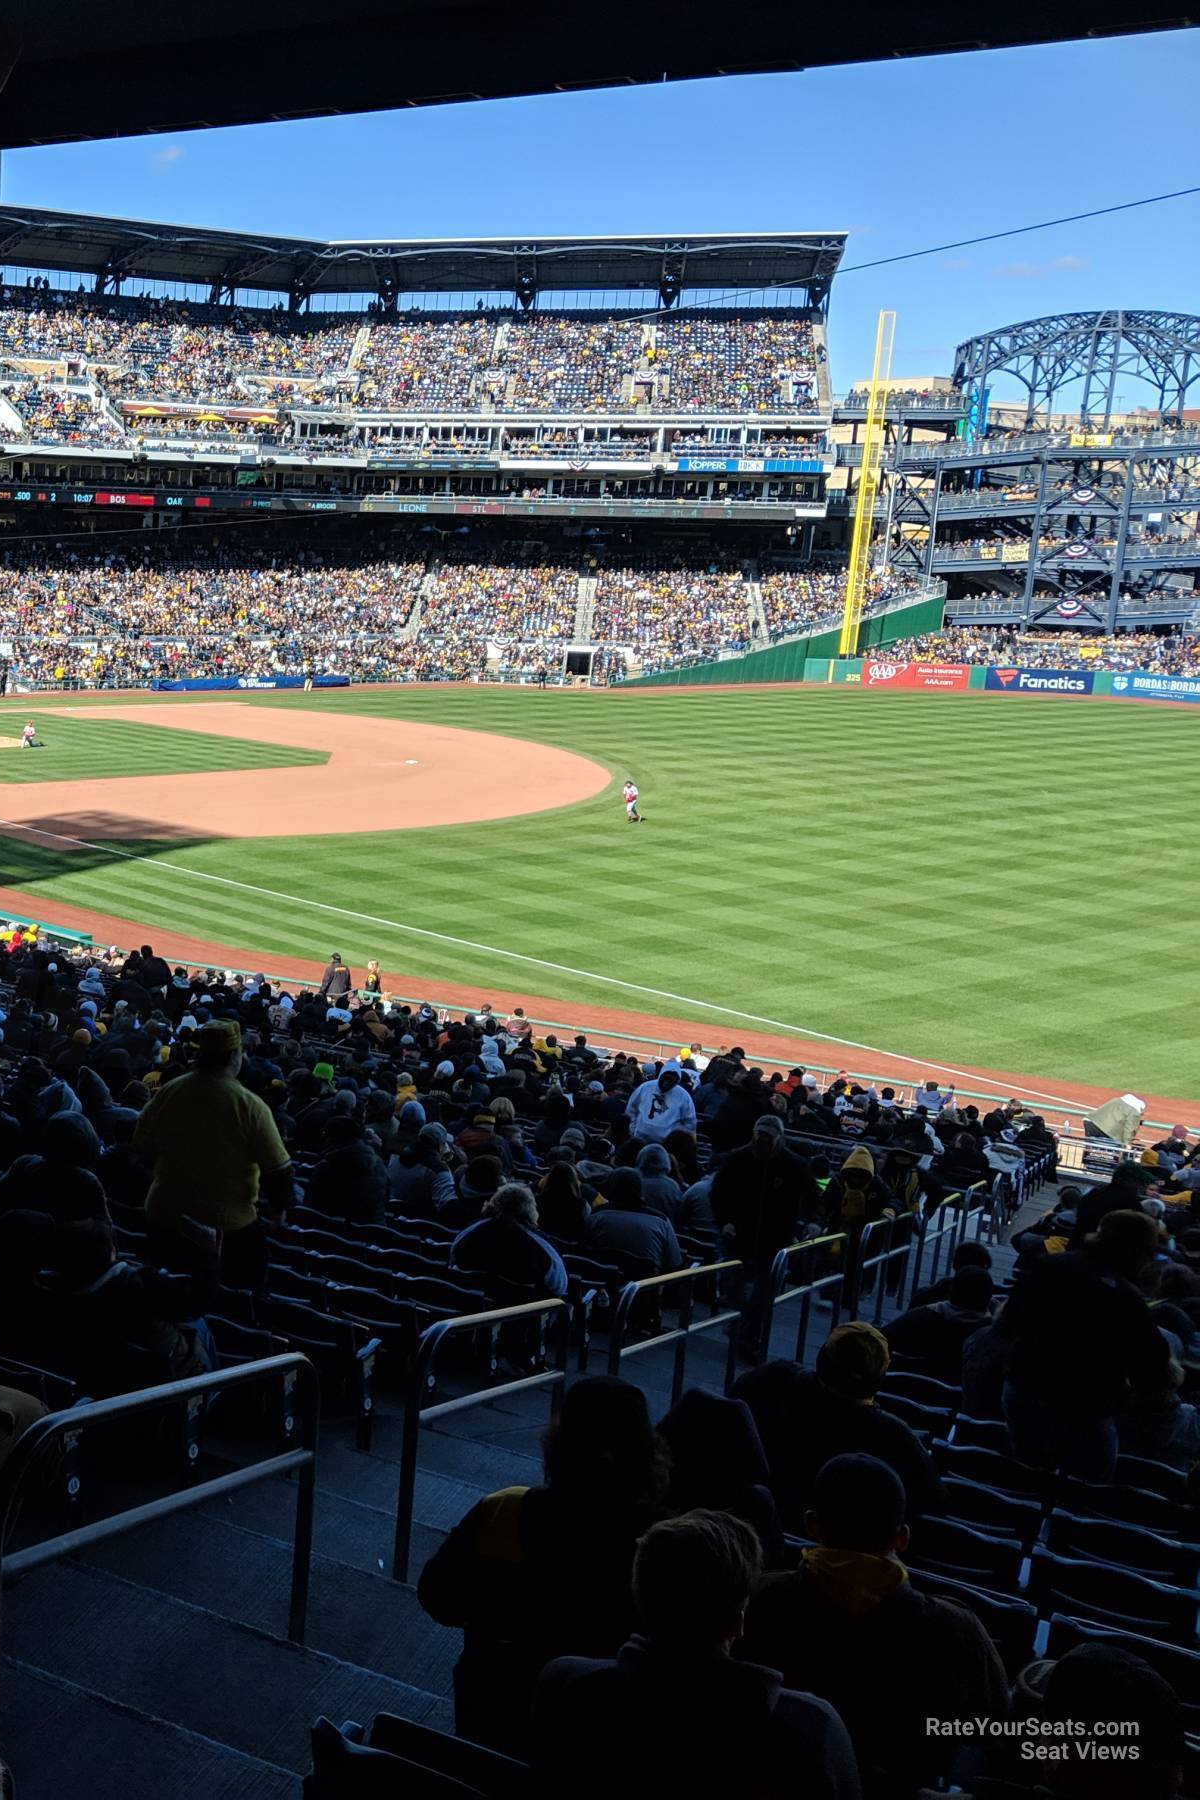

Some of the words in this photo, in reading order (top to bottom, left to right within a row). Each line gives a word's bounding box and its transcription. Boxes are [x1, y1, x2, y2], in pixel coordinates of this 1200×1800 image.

[688, 458, 726, 470] KOPPERS
[14, 492, 31, 500] .500
[50, 492, 56, 502] 2
[73, 494, 92, 503] 10:07
[110, 496, 126, 504] BOS
[166, 497, 182, 506] OAK
[399, 504, 428, 512] LEONE
[472, 504, 486, 513] STL
[934, 667, 962, 675] Insurance
[846, 674, 861, 682] 325
[1020, 674, 1085, 690] Fanatics
[1133, 677, 1167, 690] BORDAS
